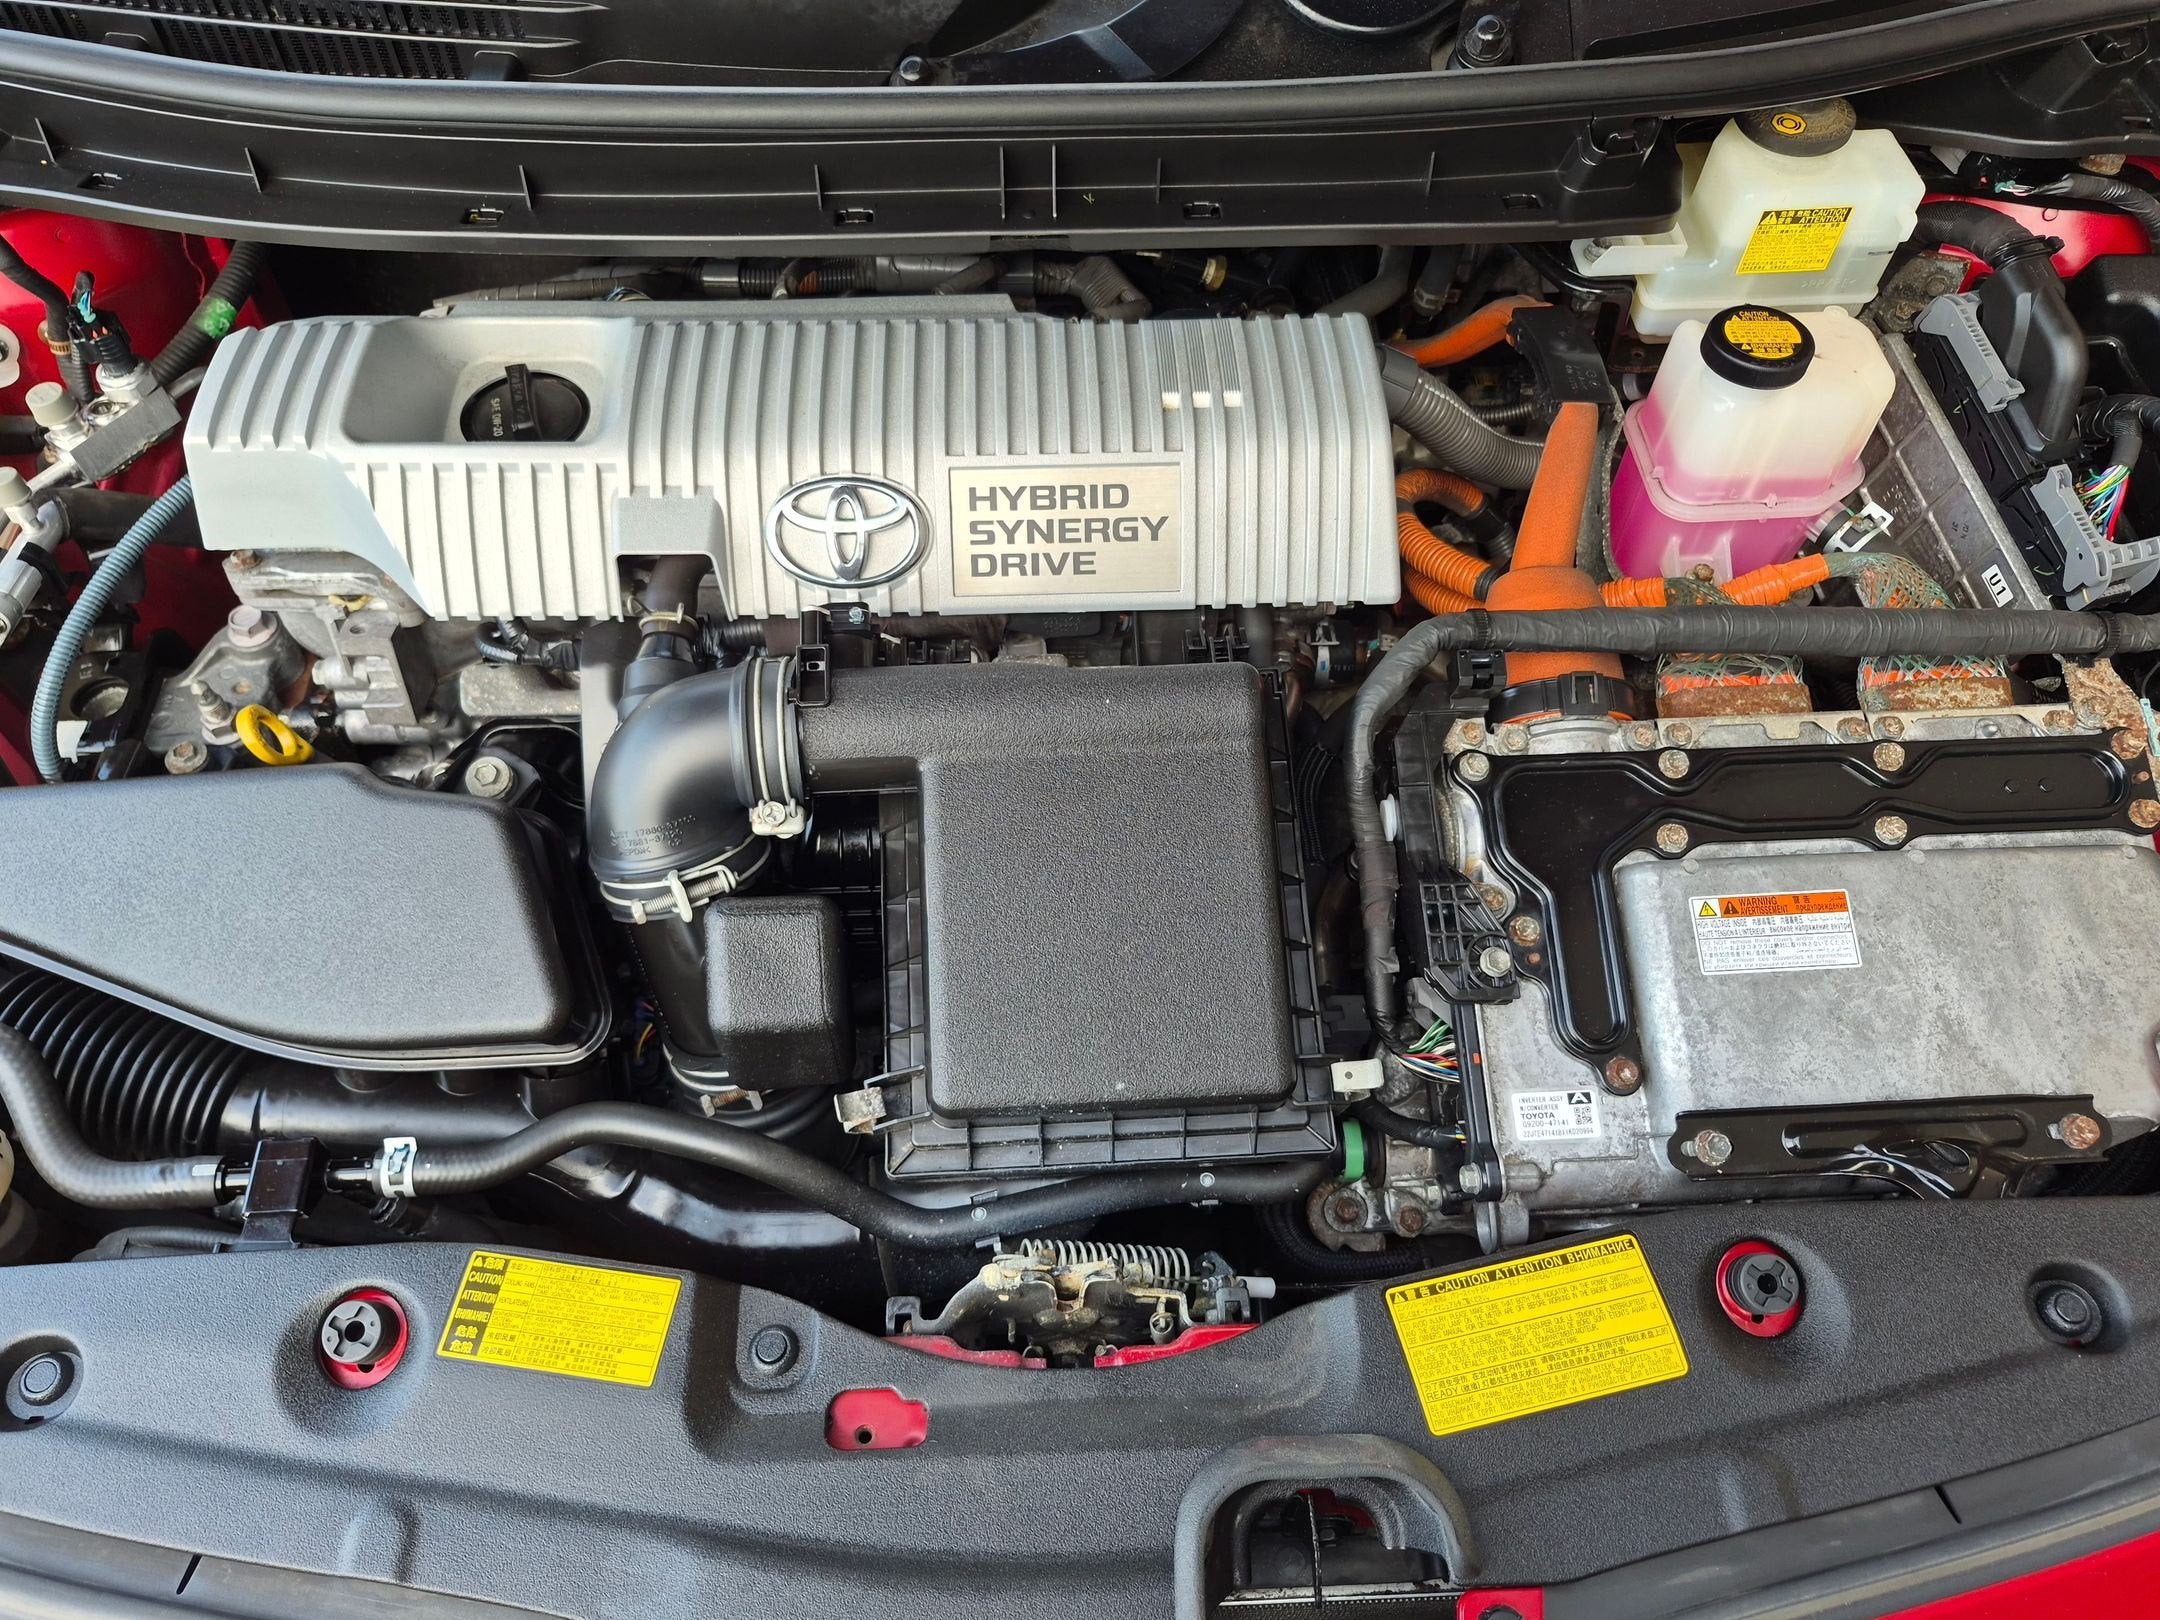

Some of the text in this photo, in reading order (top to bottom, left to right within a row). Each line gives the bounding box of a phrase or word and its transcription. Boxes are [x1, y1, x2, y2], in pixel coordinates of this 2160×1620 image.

[1798, 215, 1845, 223] ATTENTION
[1810, 208, 1848, 216] CAUTION
[969, 484, 1129, 511] HYBRID
[969, 516, 1169, 545] SYNERGY
[970, 551, 1096, 577] DRIVE
[1989, 573, 2006, 596] U1
[1738, 896, 1777, 906] WARNING
[1739, 905, 1788, 915] AVERTISSEMENT
[1696, 918, 1747, 929] HIGH VOLTAGE INSIDE
[1698, 929, 1714, 937] HAUTE
[1713, 928, 1734, 937] TENSION
[1520, 1111, 1555, 1119] TOYOTA
[1565, 1239, 1632, 1263] ВНИМАНИЕ
[467, 1270, 504, 1286] CAUTION
[1434, 1255, 1563, 1293] CAUTION ATTENTION
[460, 1288, 497, 1304] ATTENTION
[1425, 1386, 1459, 1401] READY
